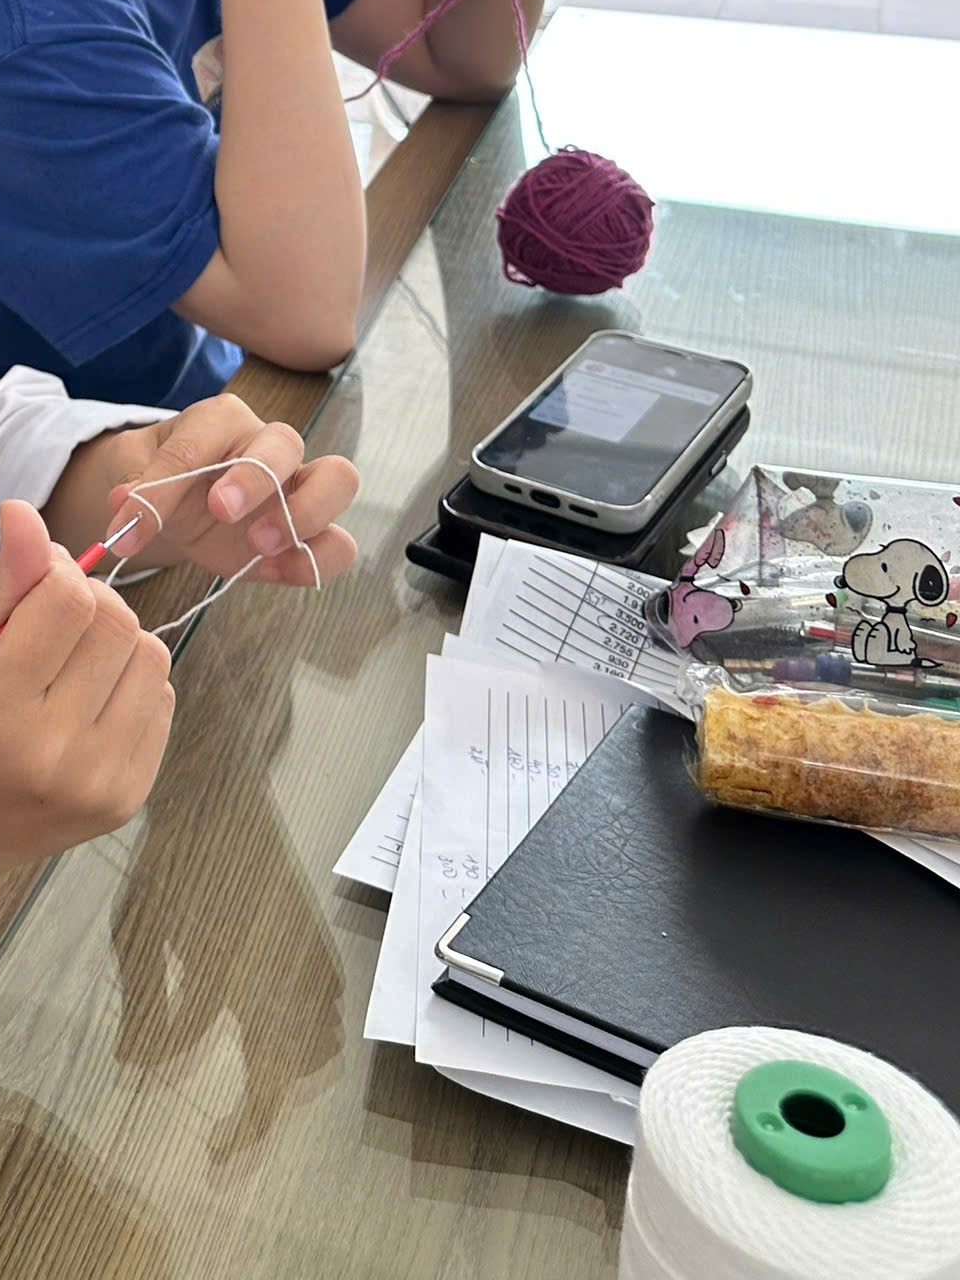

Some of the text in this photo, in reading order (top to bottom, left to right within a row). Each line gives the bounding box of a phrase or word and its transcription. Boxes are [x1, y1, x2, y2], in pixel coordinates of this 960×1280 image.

[615, 608, 645, 630] 3.500
[608, 622, 639, 644] 2.720
[603, 636, 633, 657] 2.755
